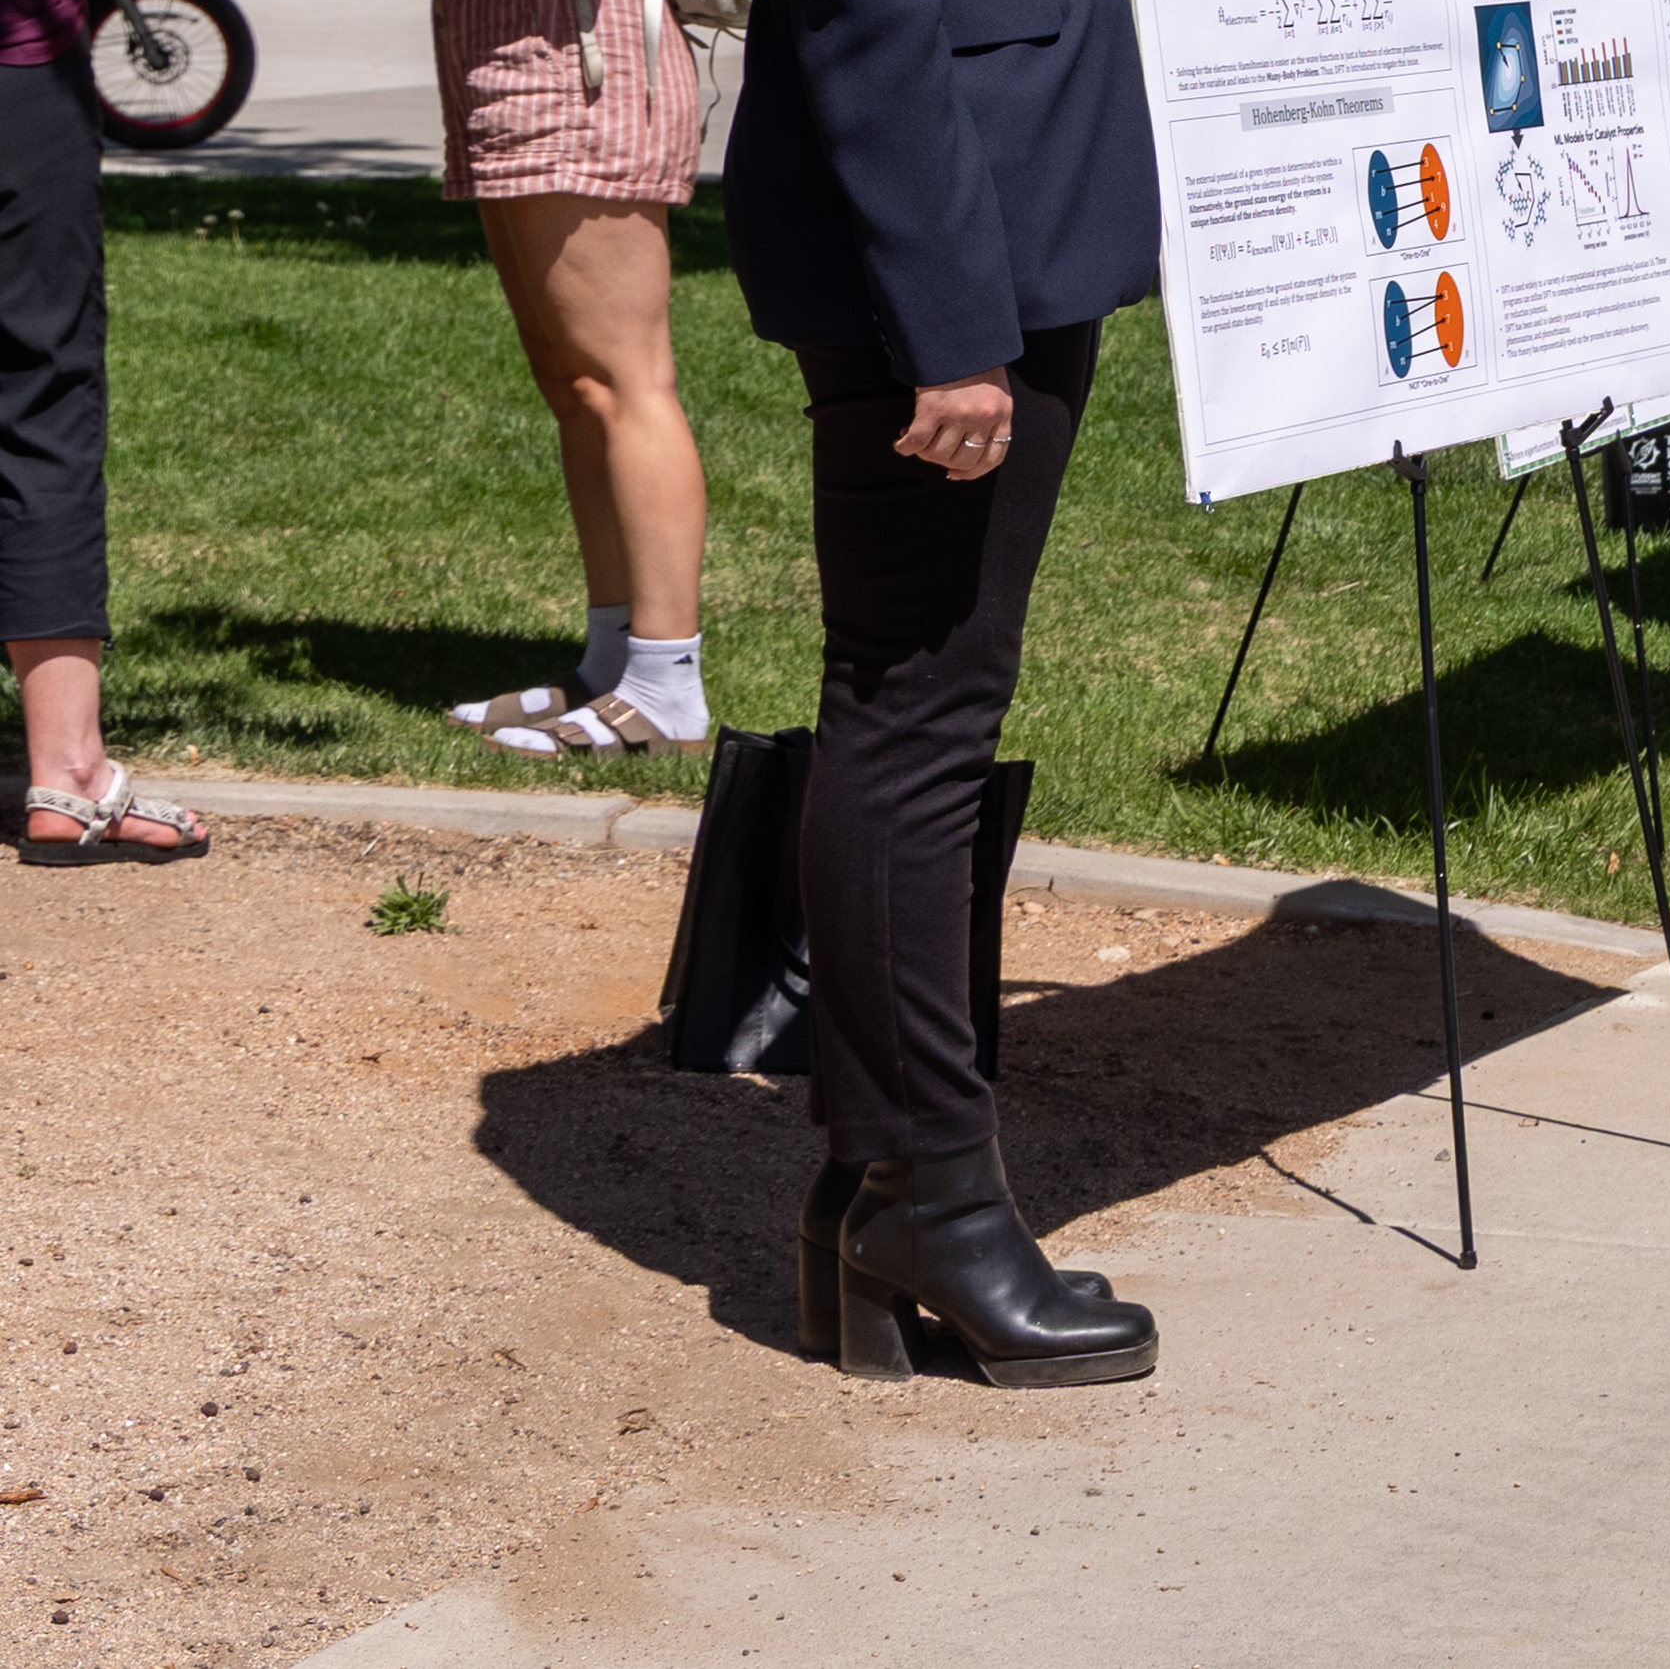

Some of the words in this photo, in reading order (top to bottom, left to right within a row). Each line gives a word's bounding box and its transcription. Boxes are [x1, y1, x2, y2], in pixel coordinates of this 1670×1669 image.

[1252, 102, 1334, 126] Hohenberg-Kohn
[1334, 96, 1386, 116] Theorems
[1553, 134, 1565, 145] ML
[1564, 131, 1584, 144] Models
[1584, 129, 1594, 142] for
[1593, 127, 1617, 142] Catalyst
[1616, 123, 1645, 139] Properties
[1423, 157, 1429, 168] 3
[1436, 171, 1442, 182] 7
[1381, 185, 1386, 196] b
[1375, 211, 1384, 220] m
[1433, 219, 1439, 229] 4
[1443, 290, 1449, 301] 3
[1395, 316, 1400, 327] b
[1446, 314, 1451, 324] 7
[1390, 341, 1398, 349] m
[1408, 379, 1420, 391] NOT
